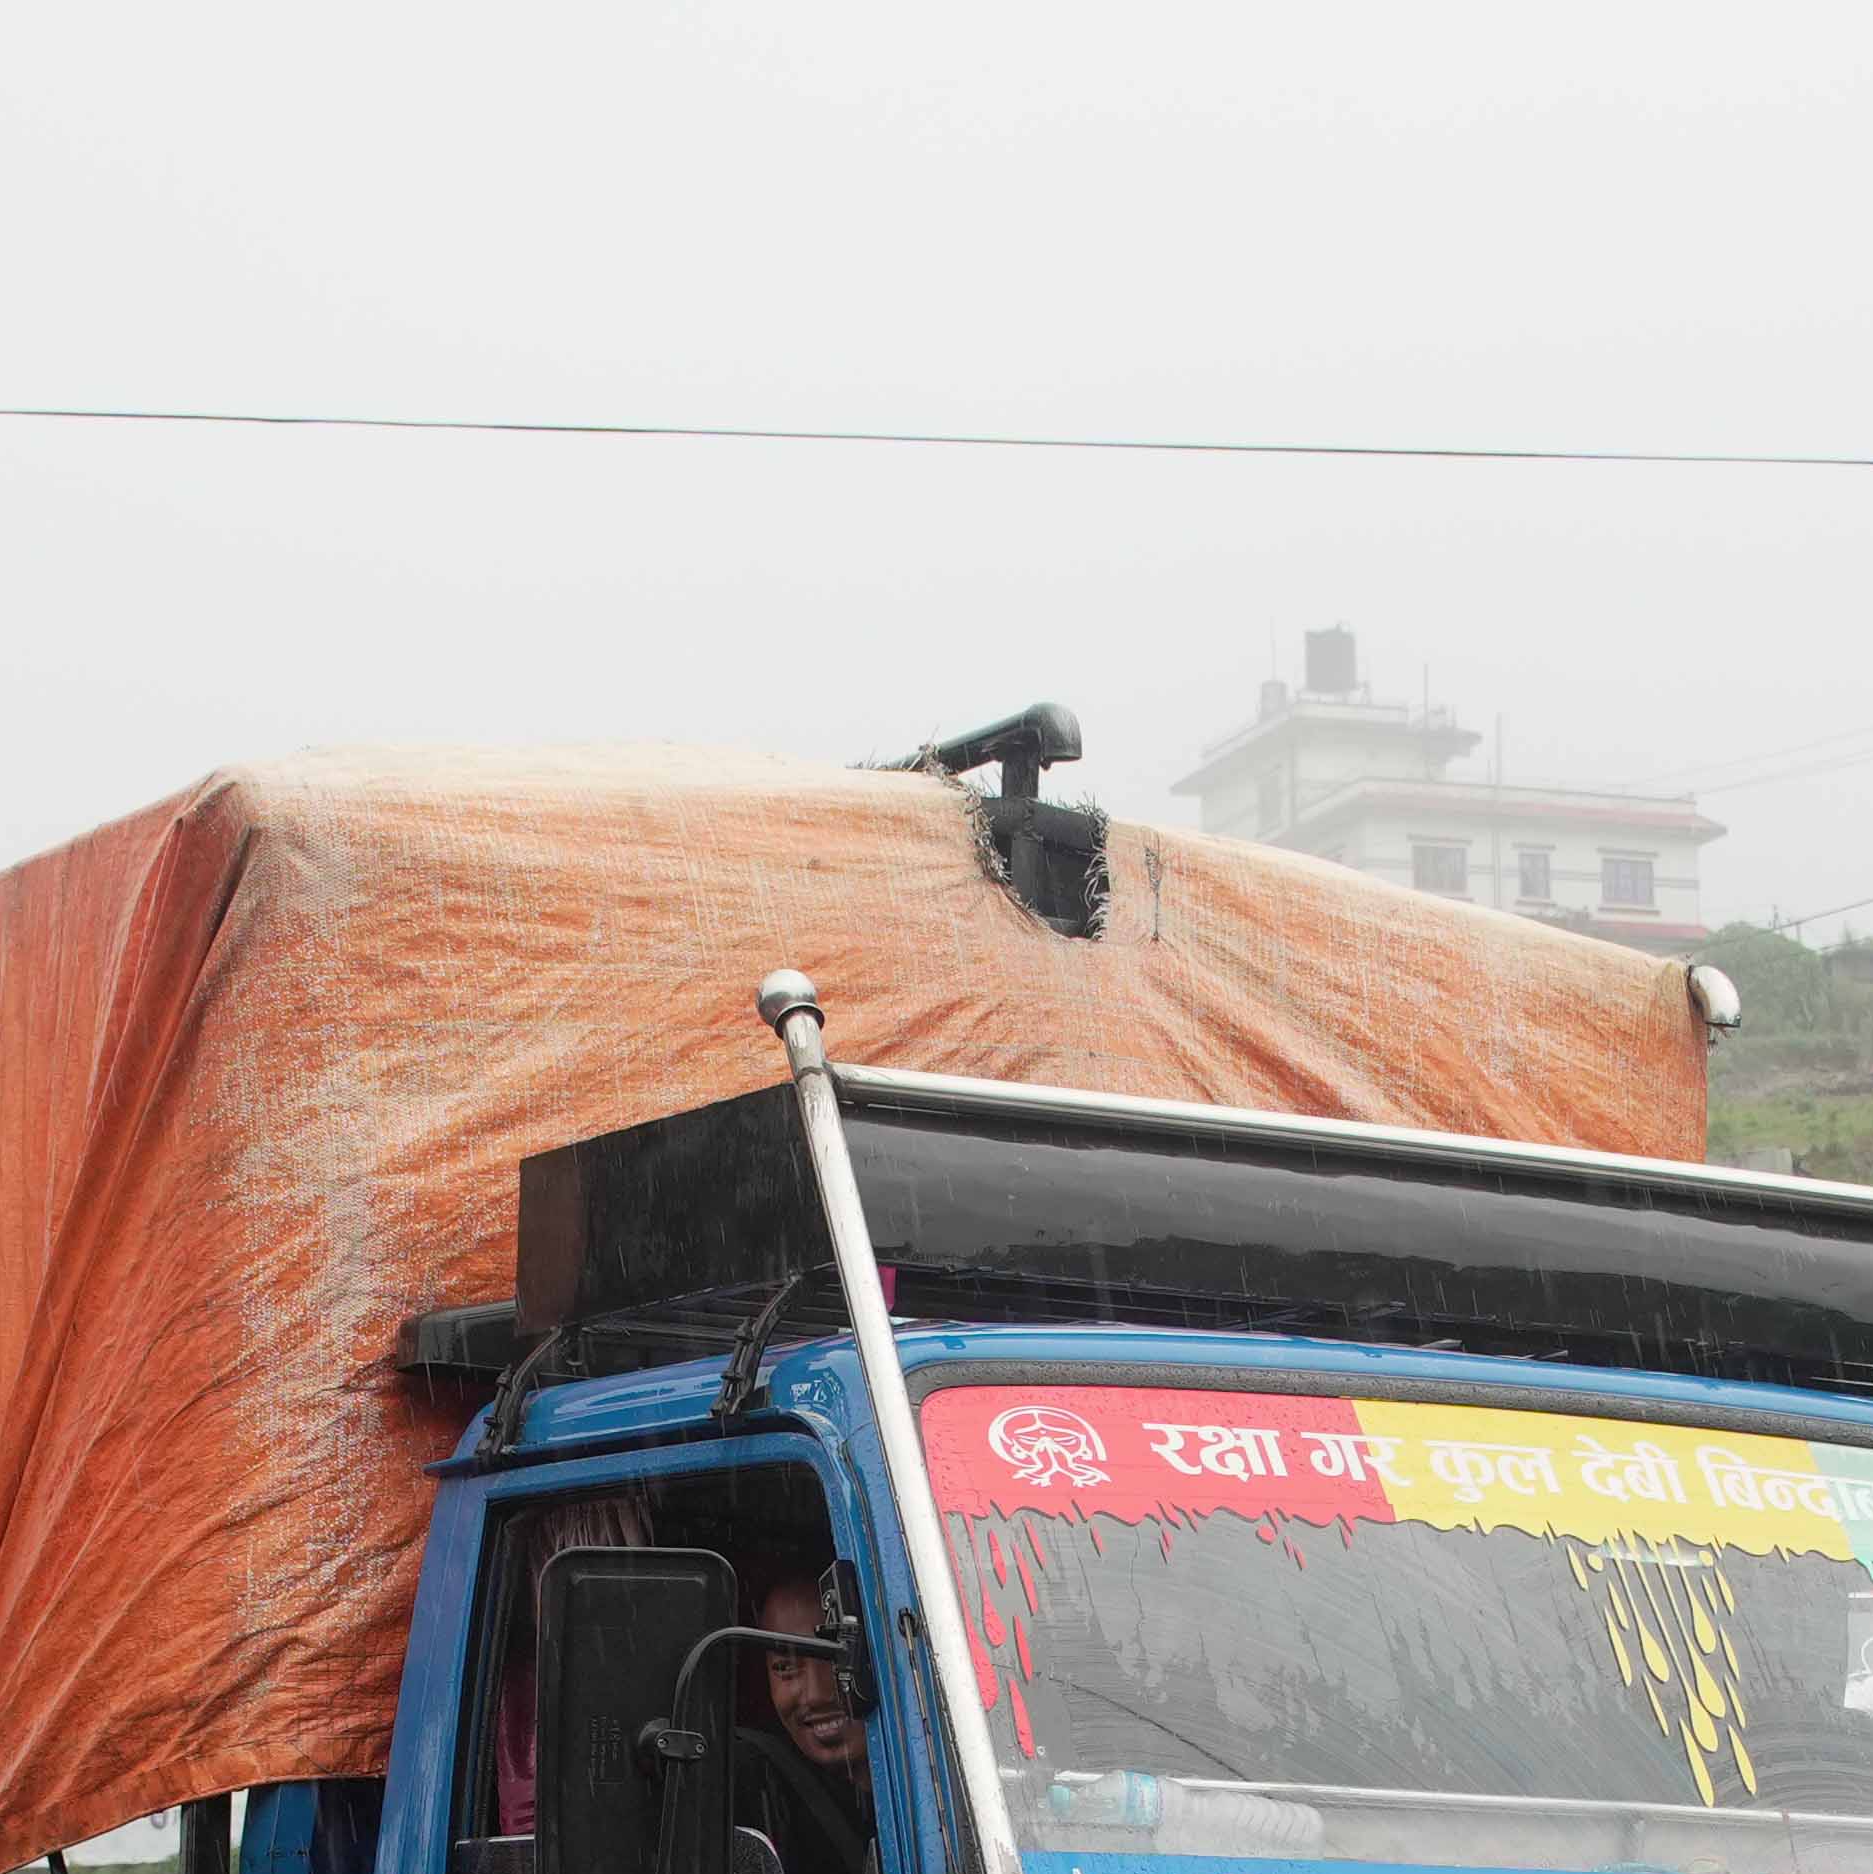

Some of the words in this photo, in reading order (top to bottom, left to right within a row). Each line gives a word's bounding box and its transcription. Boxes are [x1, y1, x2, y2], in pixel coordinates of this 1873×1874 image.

[1142, 1422, 1287, 1482] रक्षा
[1300, 1430, 1410, 1488] गर
[1424, 1438, 1561, 1502] कुल
